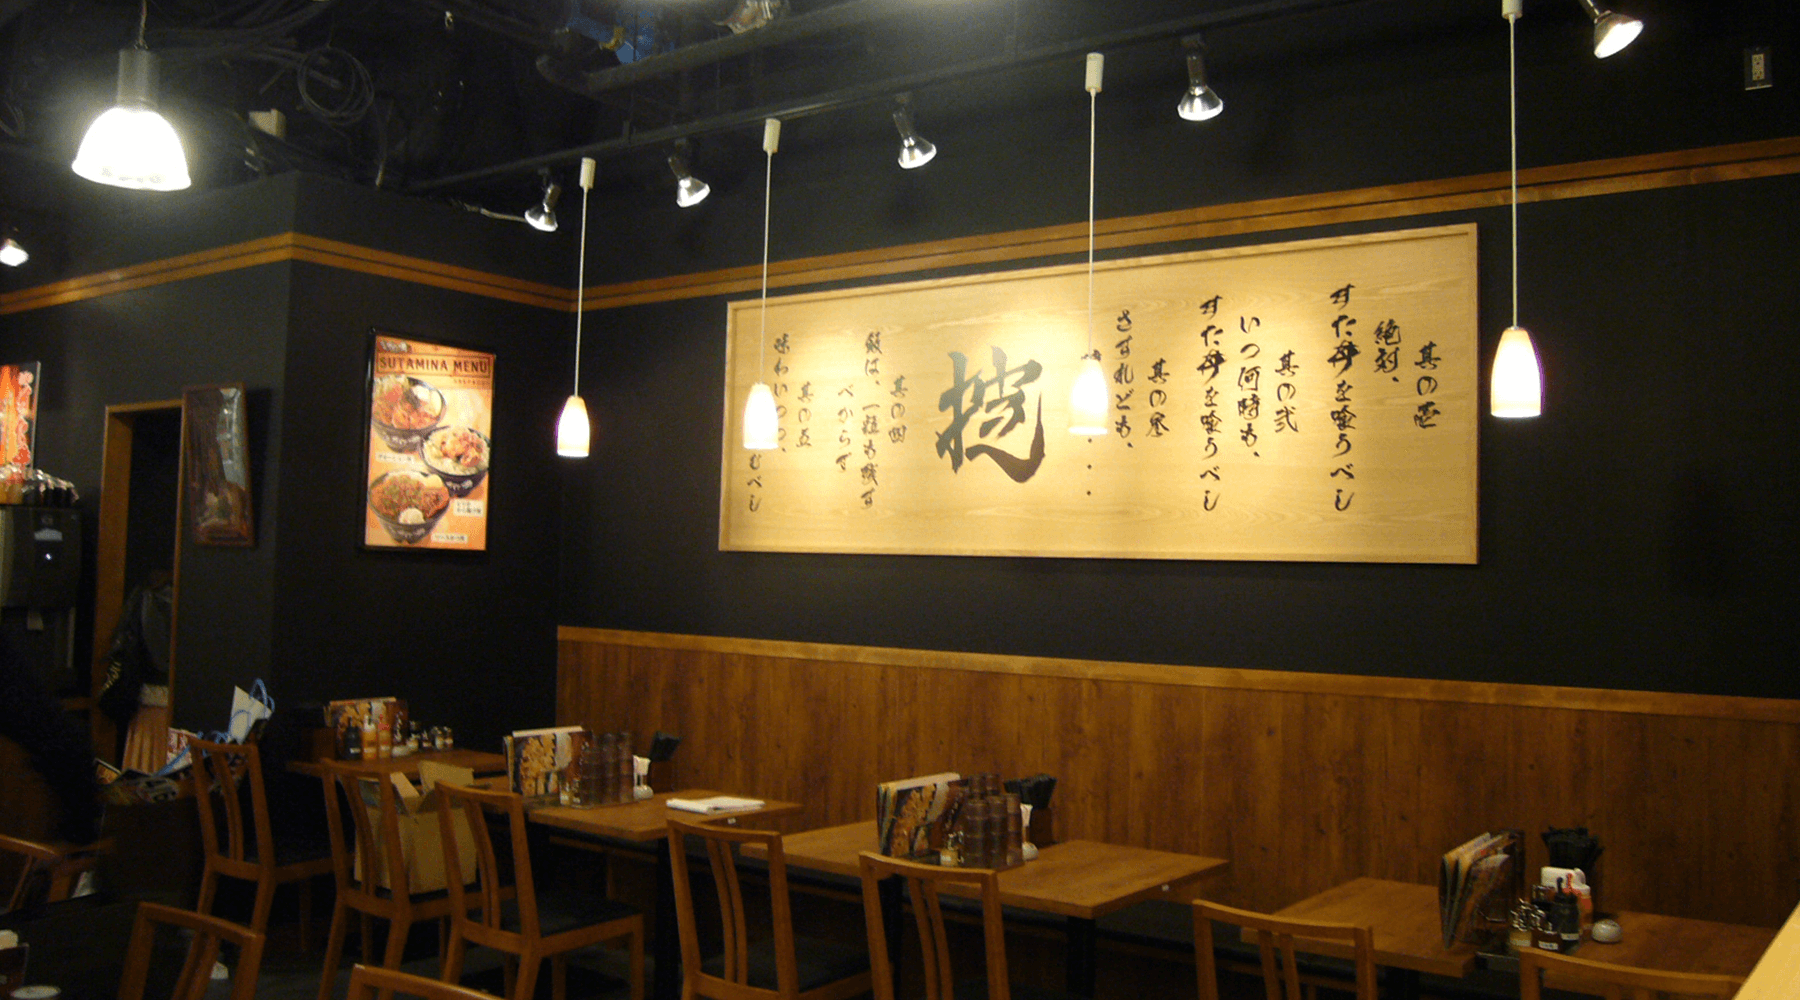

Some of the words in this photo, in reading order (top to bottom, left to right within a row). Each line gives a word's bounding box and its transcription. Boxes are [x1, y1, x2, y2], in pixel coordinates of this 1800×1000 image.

[379, 357, 448, 371] SUTAMINA
[453, 359, 488, 373] MENU
[1113, 309, 1135, 449] さすれども、
[1236, 315, 1262, 458] いつ何時も、
